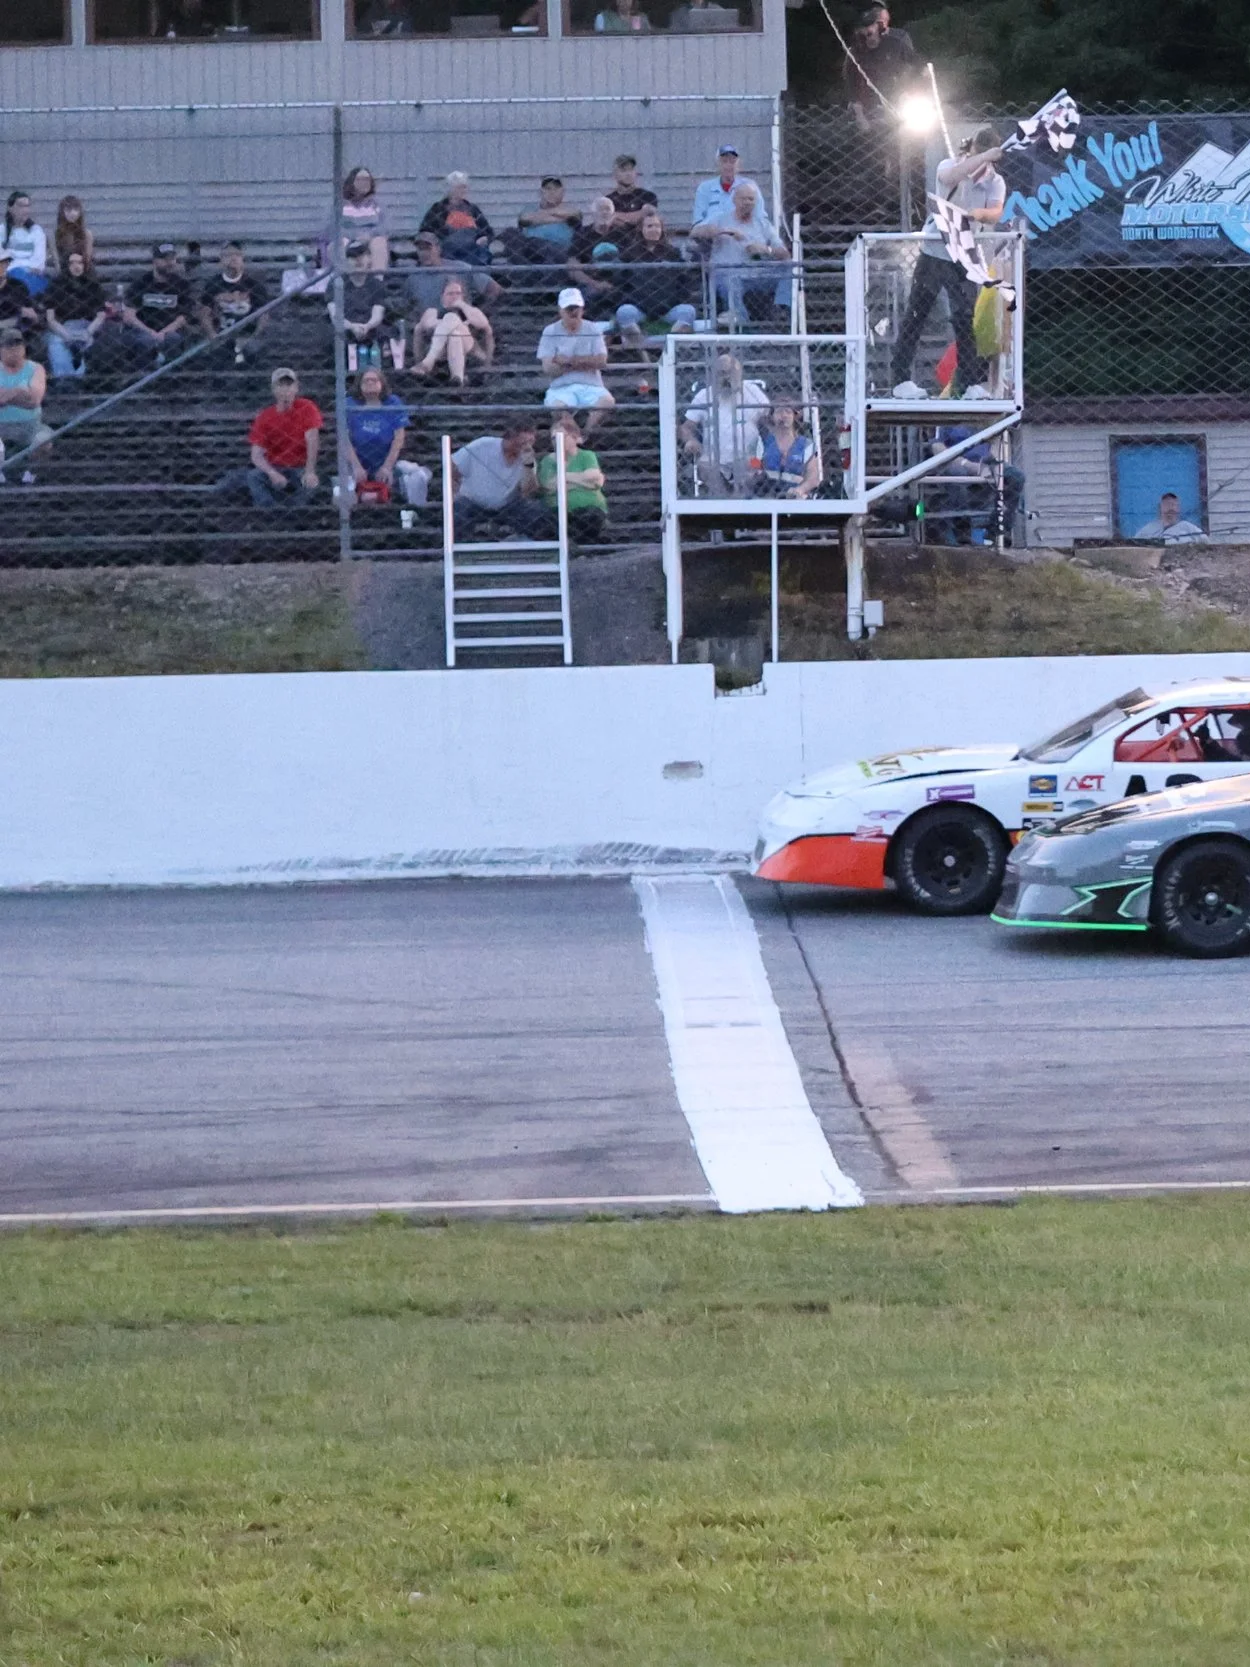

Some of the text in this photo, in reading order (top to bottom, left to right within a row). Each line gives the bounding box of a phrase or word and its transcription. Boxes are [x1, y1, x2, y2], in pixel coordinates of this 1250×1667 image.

[1125, 169, 1228, 210] White
[1122, 225, 1220, 240] NORTH WOODSTOCK
[1064, 775, 1106, 792] ACT
